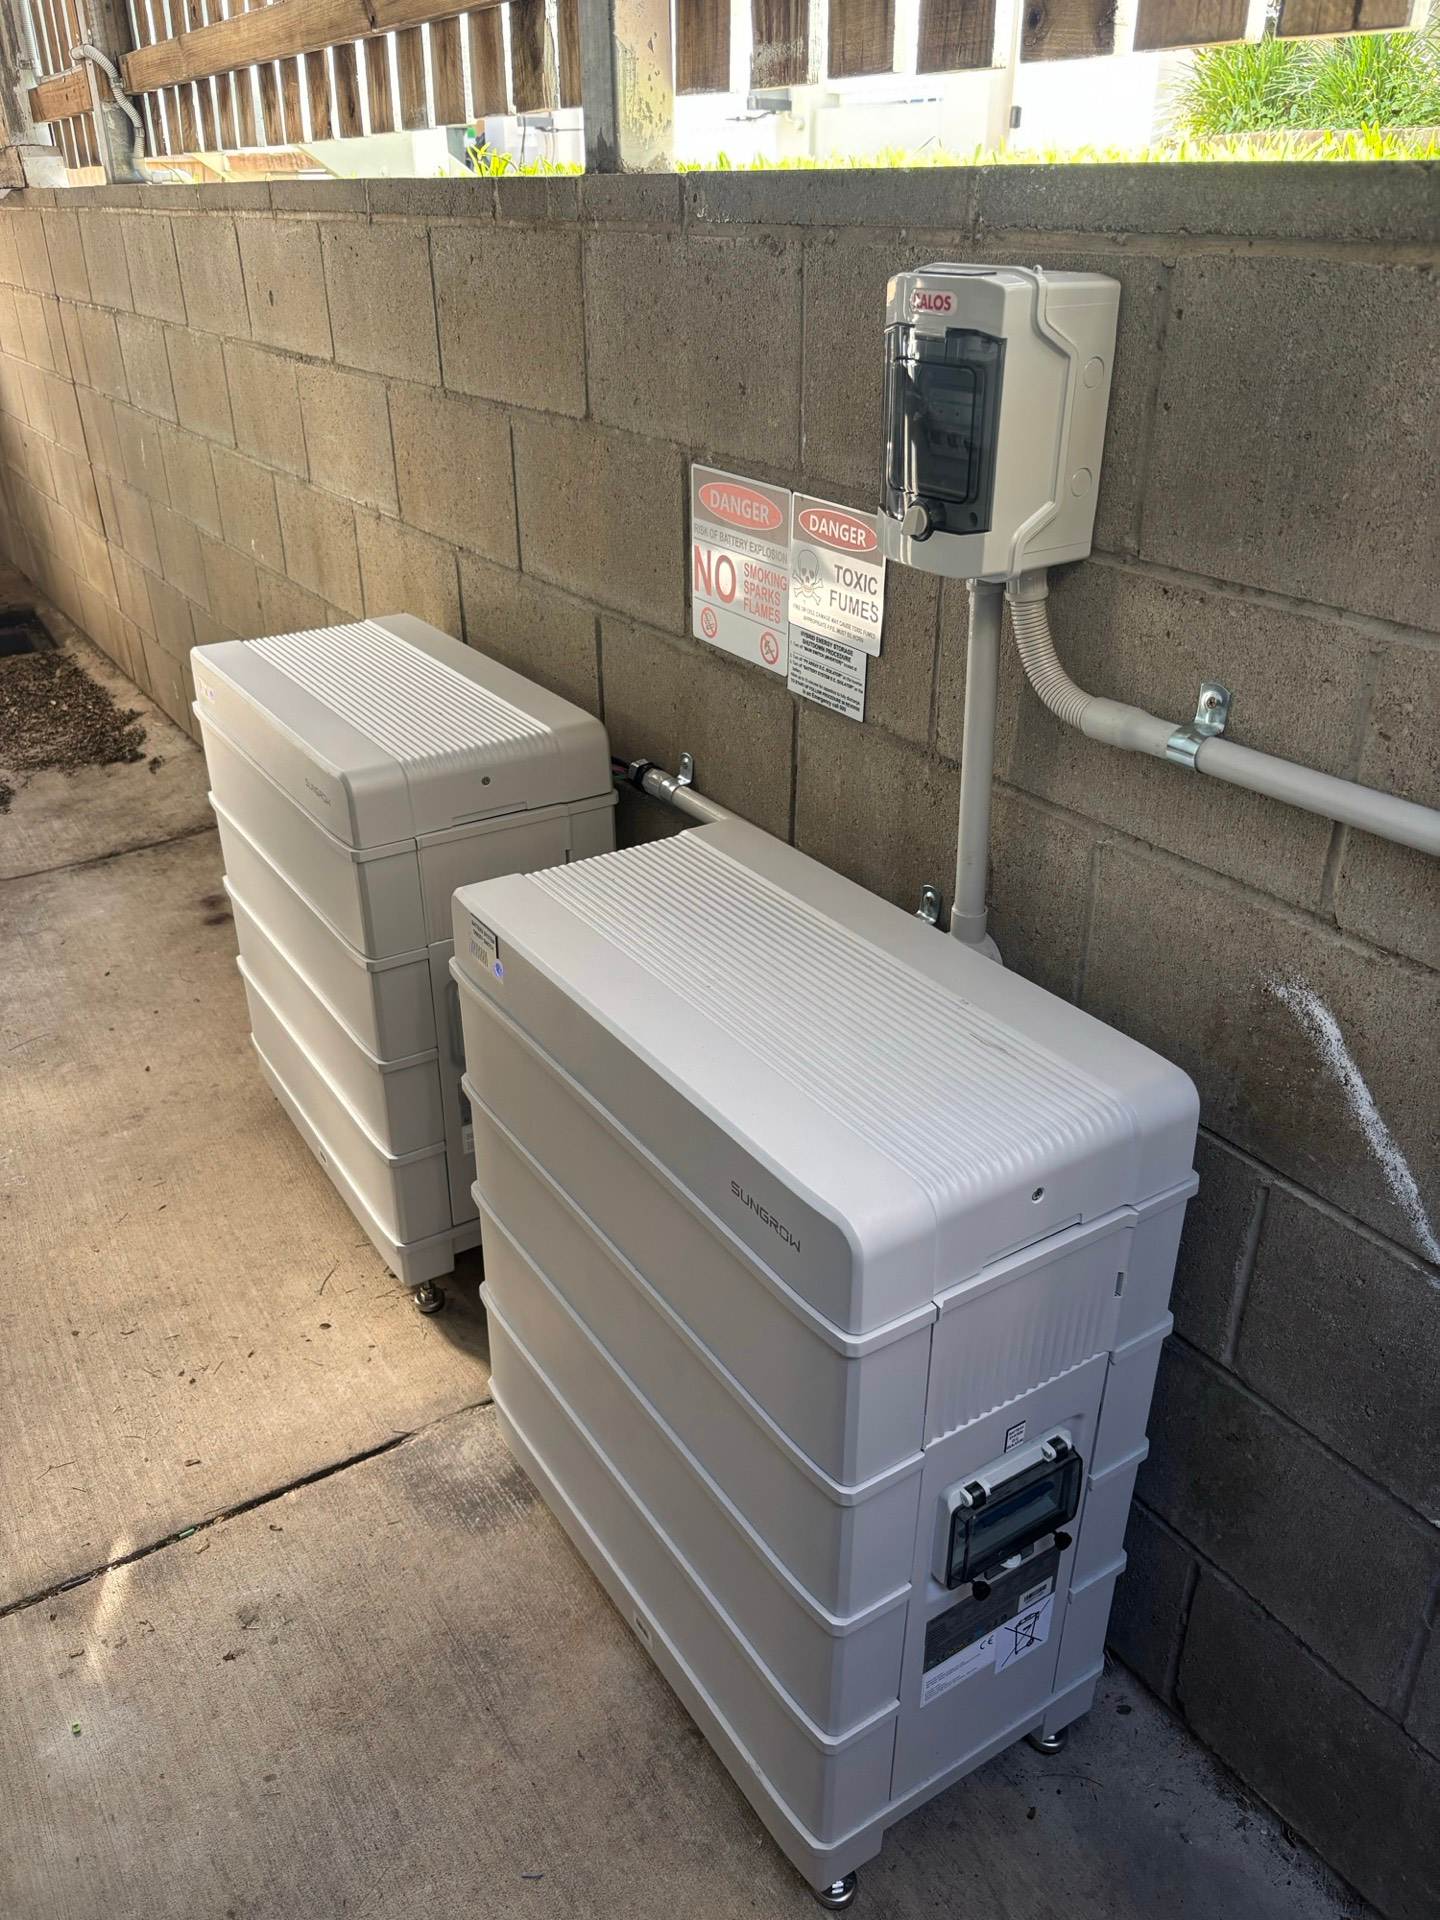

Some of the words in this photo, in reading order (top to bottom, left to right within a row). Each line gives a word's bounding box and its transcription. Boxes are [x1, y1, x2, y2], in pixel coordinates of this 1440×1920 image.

[710, 489, 769, 526] DANGER
[695, 523, 708, 536] RISK
[711, 529, 718, 539] OF
[720, 532, 748, 550] BATTERY
[749, 541, 788, 564] EXPLOSION
[809, 515, 866, 548] DANGER
[694, 543, 737, 604] NO
[744, 563, 787, 592] SMOKING
[834, 564, 878, 595] TOXIC
[744, 580, 781, 607] SPARKS
[829, 589, 879, 623] FUMES
[744, 597, 780, 624] FLAMES
[731, 1181, 801, 1253] SUNGROW
